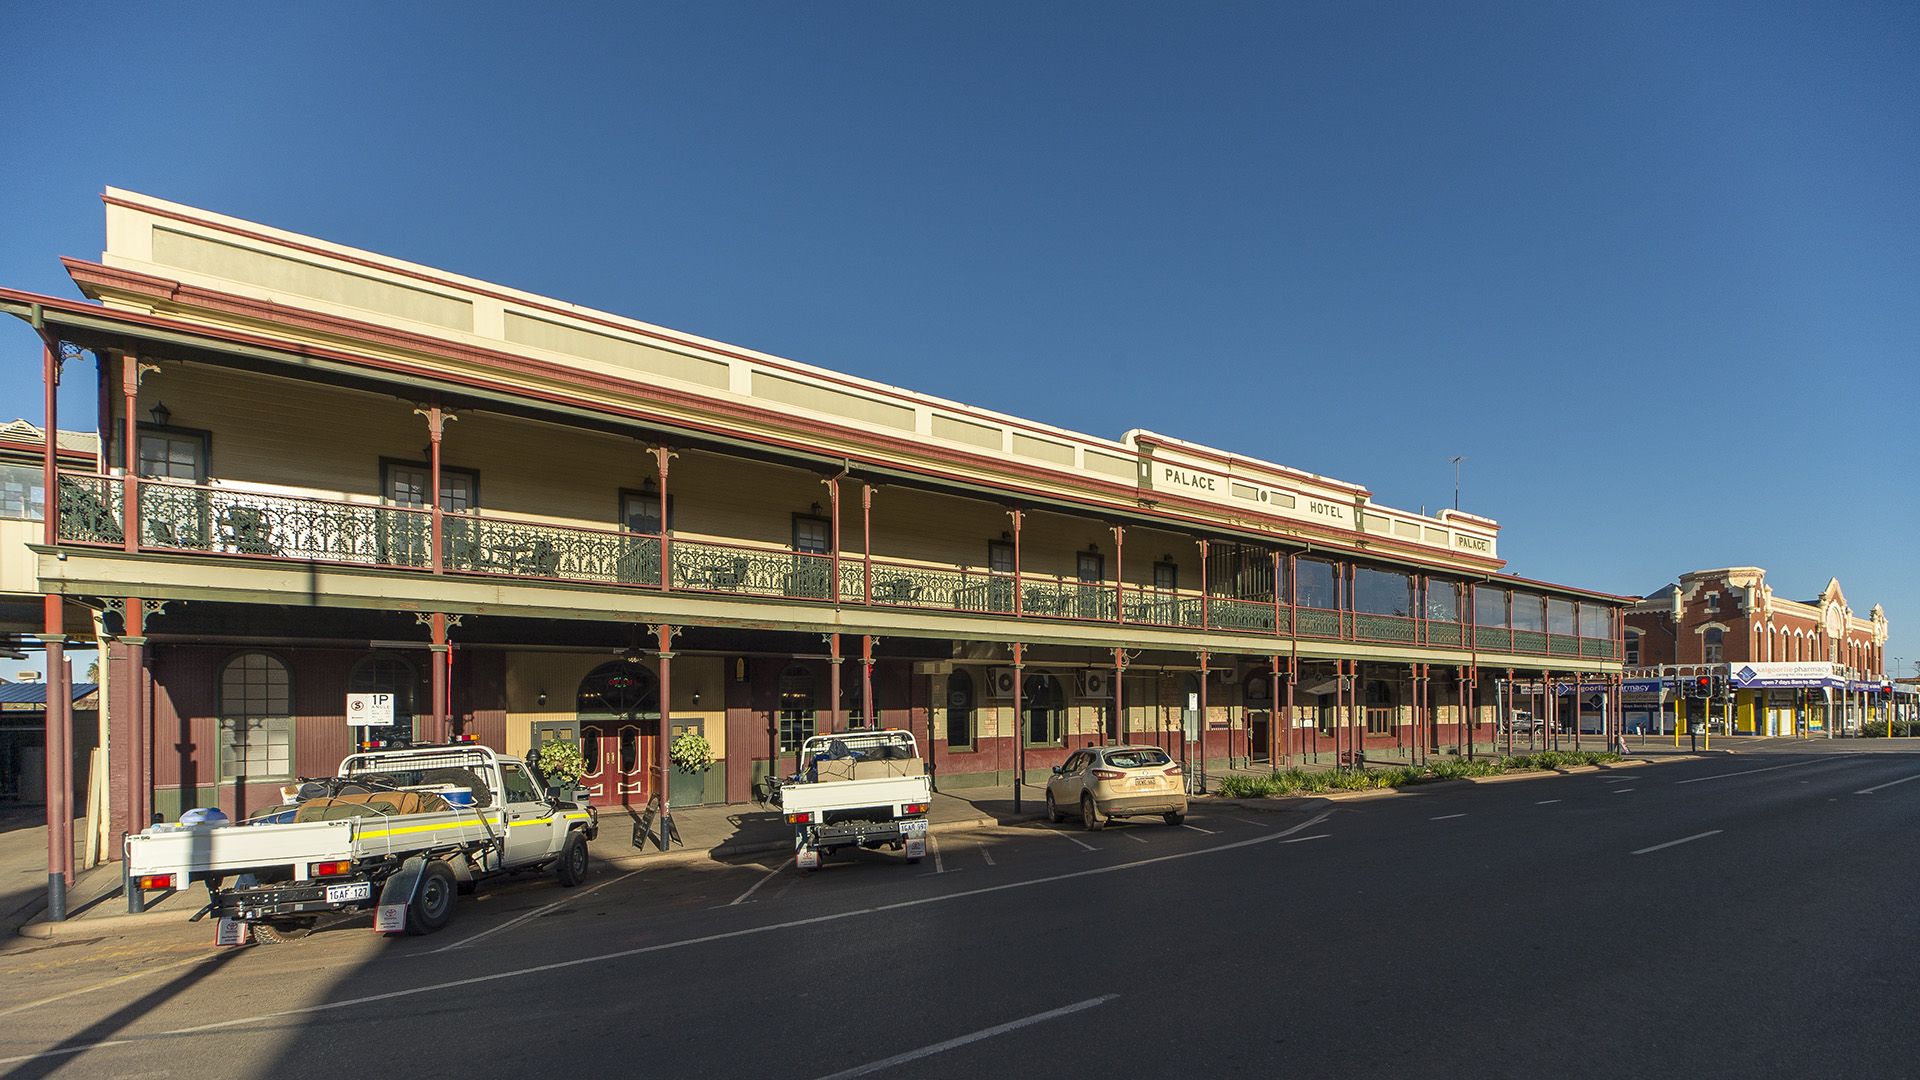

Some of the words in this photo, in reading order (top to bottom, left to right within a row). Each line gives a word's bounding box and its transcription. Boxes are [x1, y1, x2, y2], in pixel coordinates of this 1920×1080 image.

[1165, 468, 1215, 491] PALACE
[1310, 501, 1343, 518] HOTEL
[1458, 536, 1486, 551] PALACE
[1756, 665, 1793, 674] kalgoorlie
[1794, 665, 1830, 674] pharmacy
[1568, 684, 1608, 692] kagoorlie
[372, 694, 389, 705] 1P
